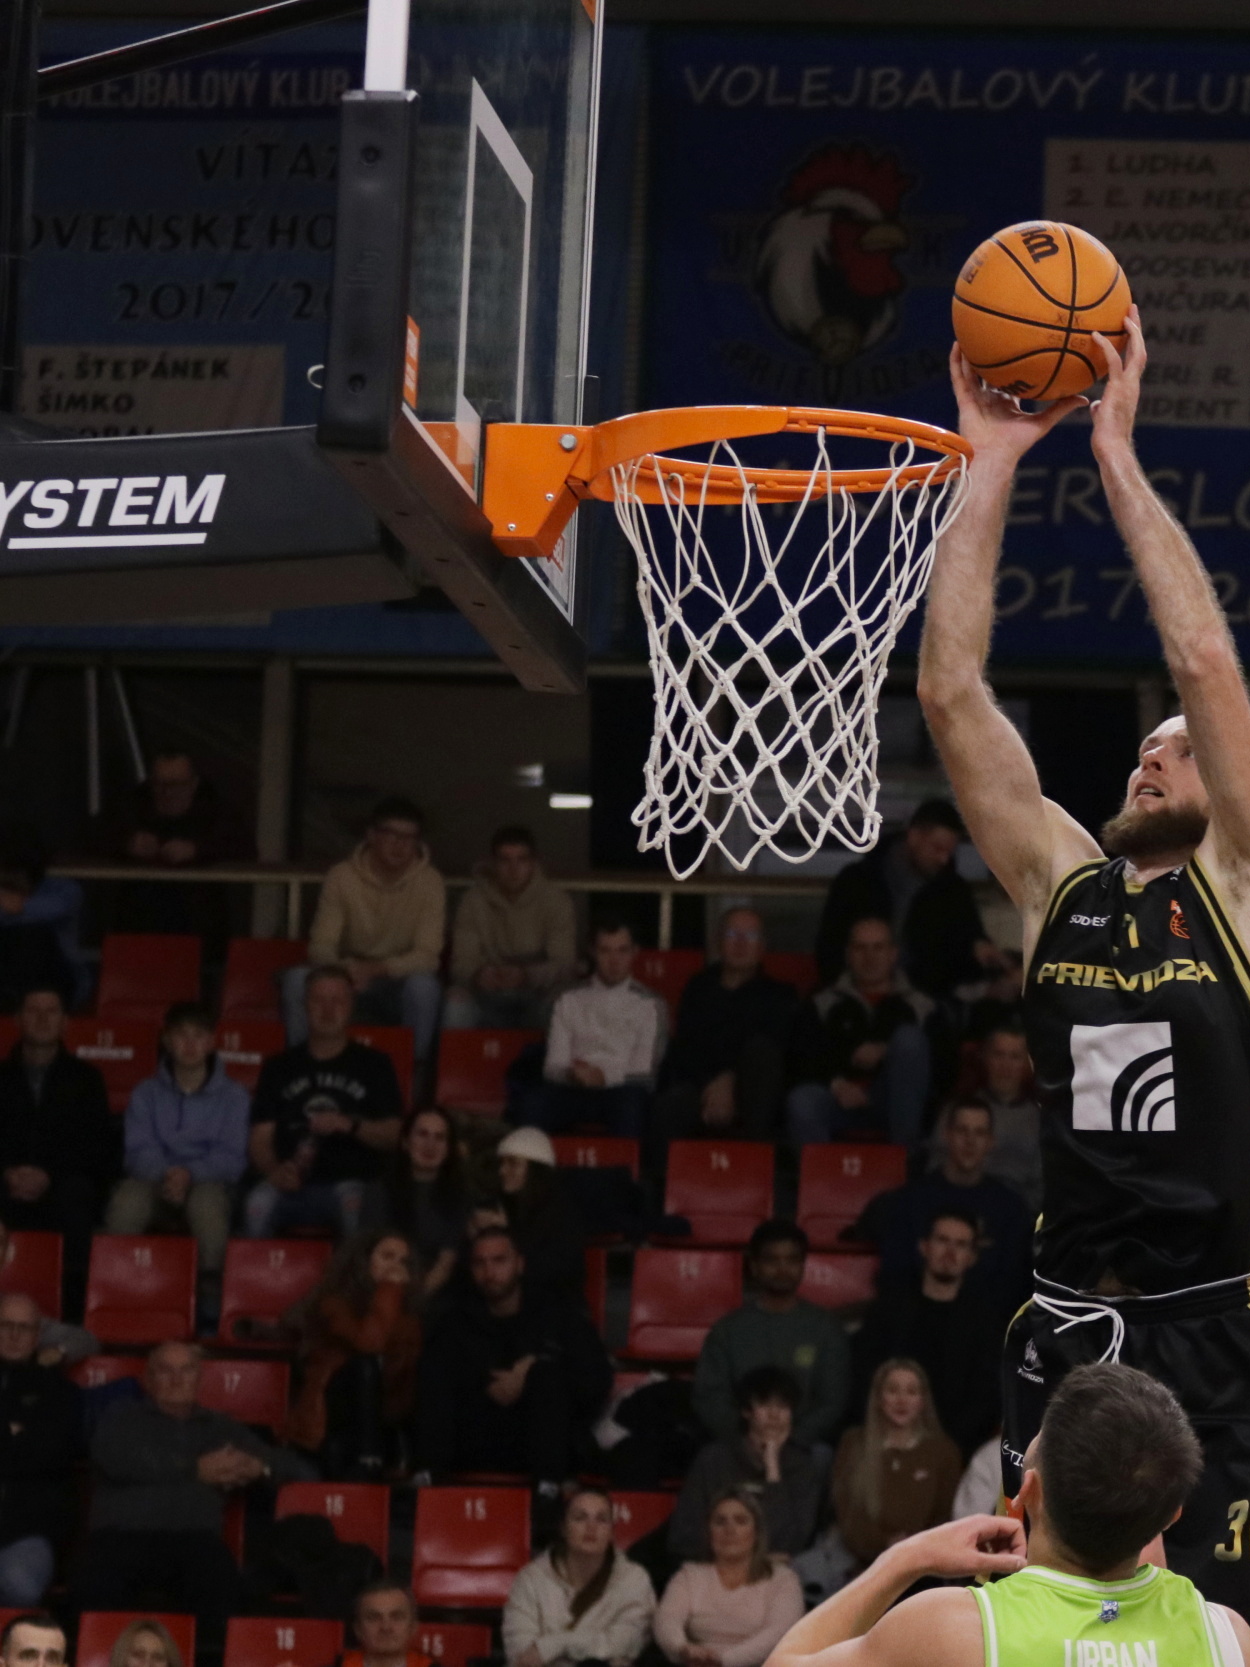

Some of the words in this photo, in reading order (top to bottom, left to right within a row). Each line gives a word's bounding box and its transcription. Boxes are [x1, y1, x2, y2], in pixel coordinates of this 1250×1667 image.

[269, 69, 350, 107] KLUB
[685, 53, 1102, 113] VOLEJBALOVÝ
[117, 280, 334, 322] 2017/2
[75, 349, 230, 380] ŠTEPÁNEK
[37, 386, 137, 415] ŠIMKO
[1037, 957, 1219, 994] PRIEVIDZA
